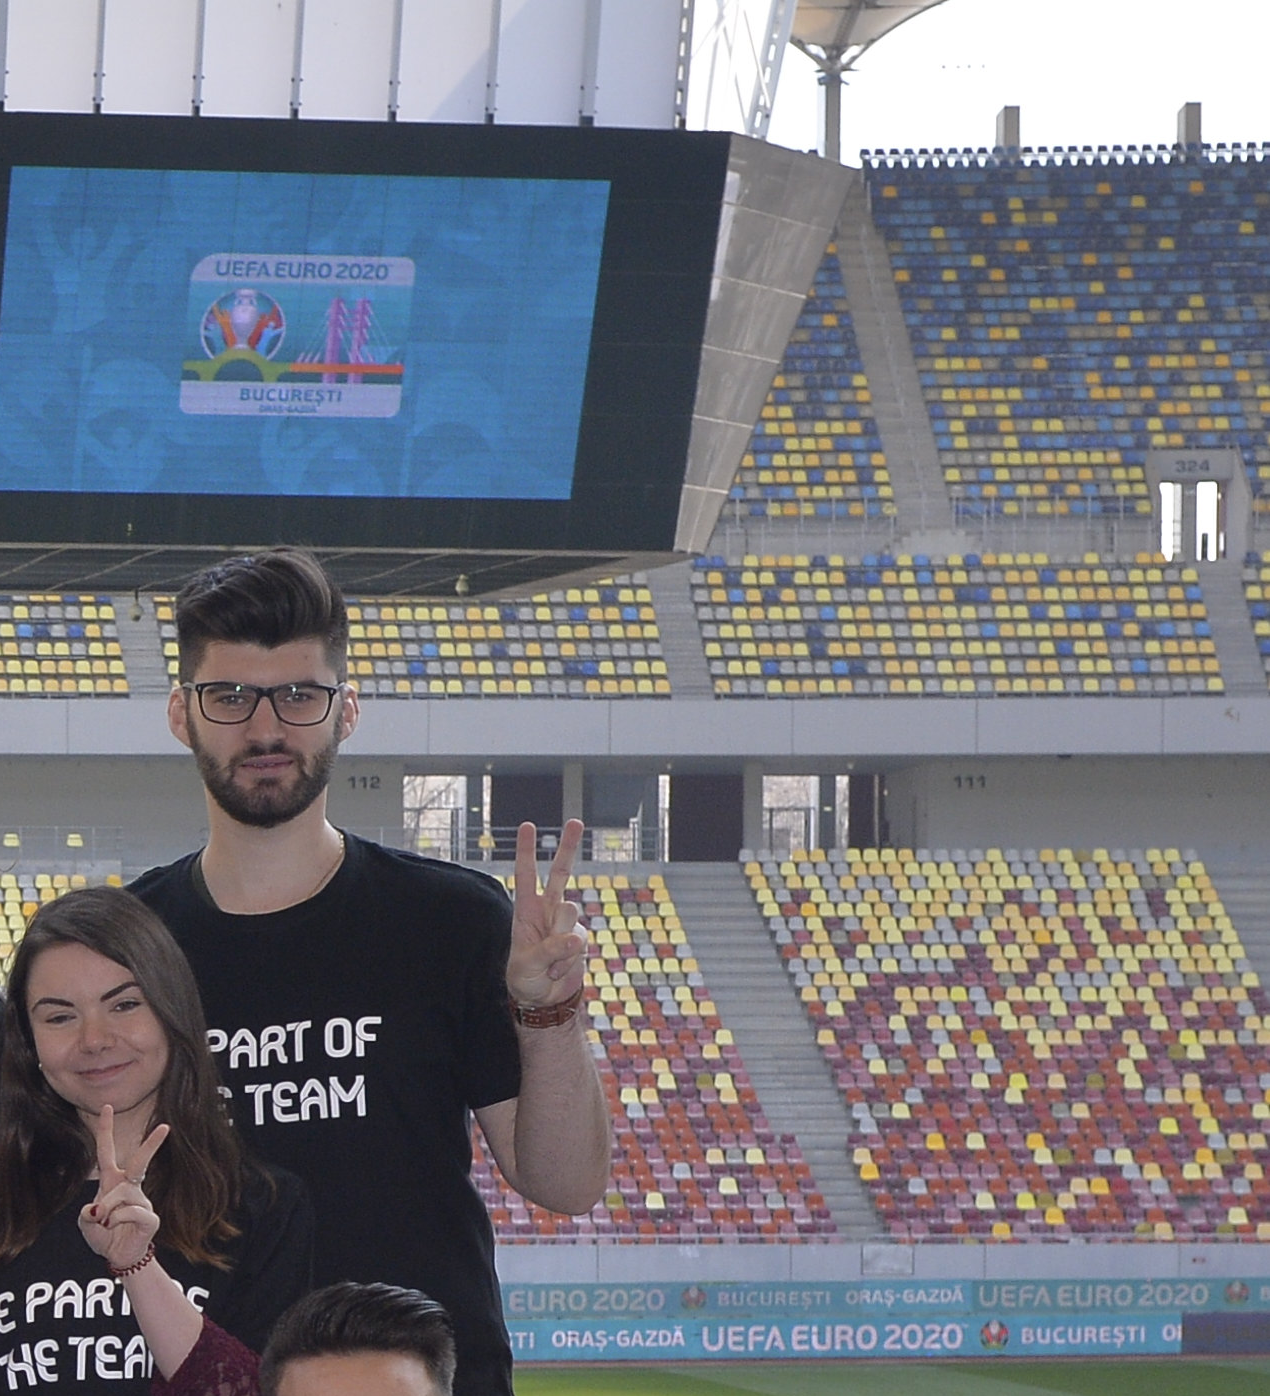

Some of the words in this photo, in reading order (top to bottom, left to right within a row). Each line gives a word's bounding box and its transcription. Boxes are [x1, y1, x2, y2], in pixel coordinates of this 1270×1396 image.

[215, 260, 271, 278] UEFA
[274, 261, 332, 279] EURO
[335, 262, 389, 281] 2020
[1175, 459, 1210, 473] 324
[347, 775, 381, 790] 112
[953, 775, 987, 789] 111
[324, 1016, 382, 1058] OF
[244, 1075, 367, 1126] TEAM
[509, 1288, 587, 1312] EURO
[592, 1287, 665, 1311] 2020
[979, 1284, 1054, 1308] UEFA
[1058, 1284, 1133, 1308] EURO
[1138, 1283, 1209, 1306] 2020
[702, 1325, 785, 1351] UEFA
[791, 1324, 877, 1350] EURO
[883, 1323, 963, 1350] 2020
[68, 1335, 154, 1381] TEA
